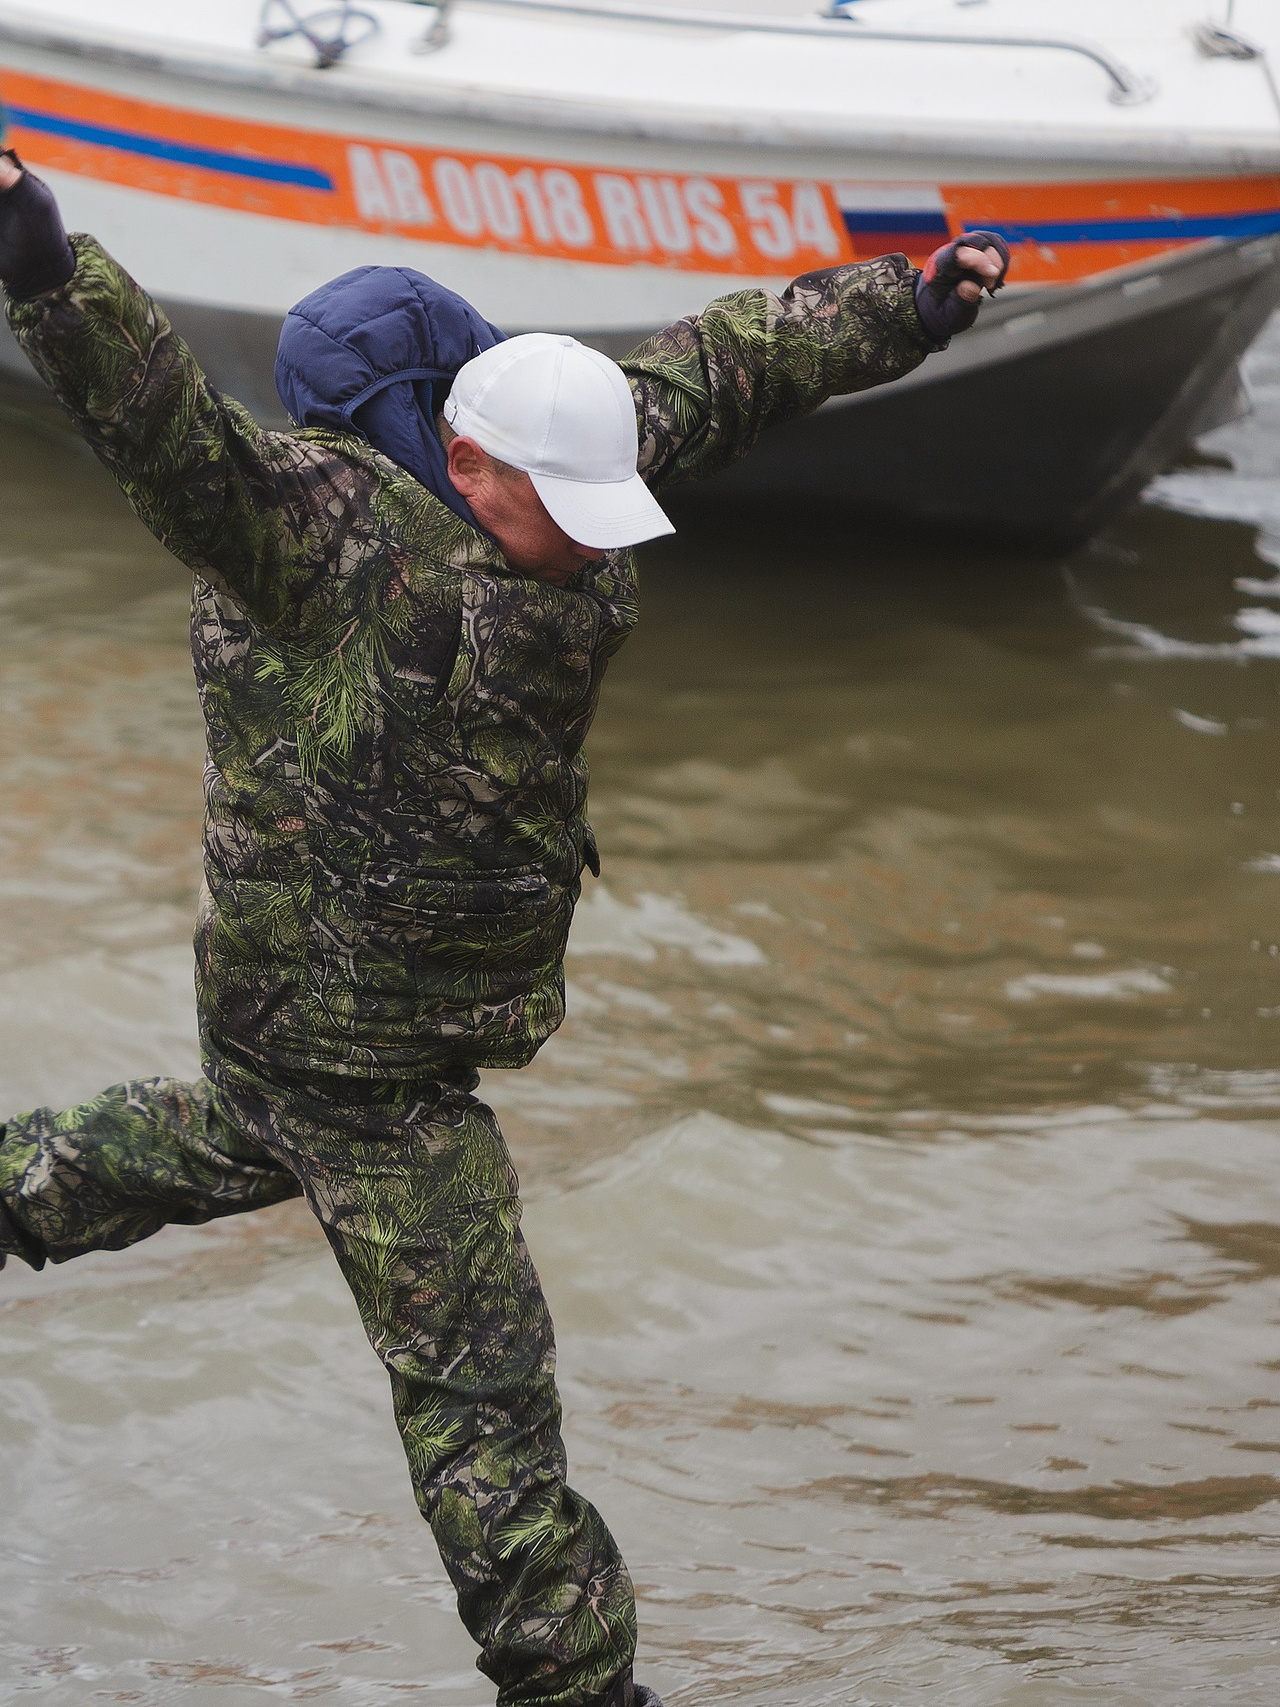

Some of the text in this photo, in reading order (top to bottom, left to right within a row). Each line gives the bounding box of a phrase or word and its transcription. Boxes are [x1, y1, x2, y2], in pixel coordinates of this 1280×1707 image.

[430, 155, 595, 247] 0018
[592, 171, 737, 259] RUS
[736, 178, 841, 261] 54
